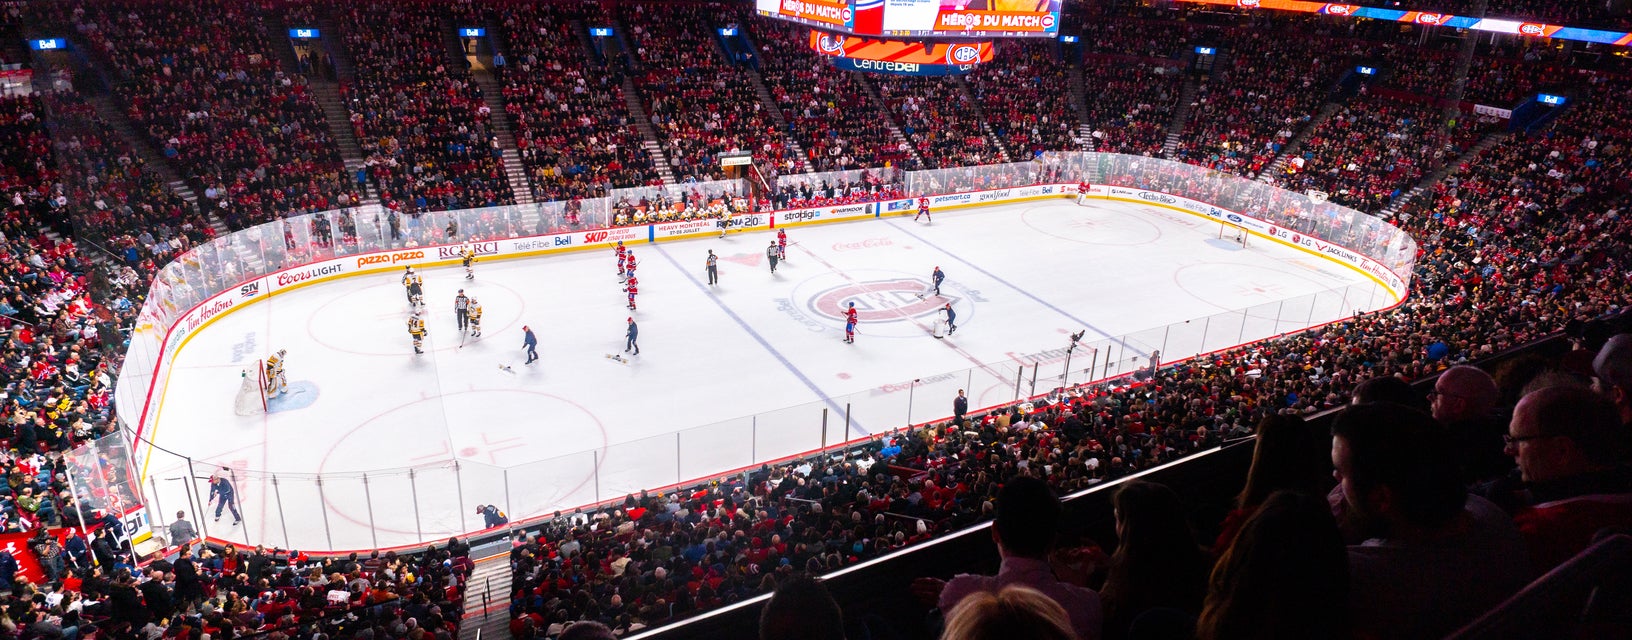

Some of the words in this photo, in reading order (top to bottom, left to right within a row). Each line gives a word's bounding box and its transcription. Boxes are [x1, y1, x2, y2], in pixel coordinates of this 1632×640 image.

[805, 3, 815, 14] DU
[816, 5, 840, 19] MATCH
[942, 13, 981, 26] HÉROS
[983, 15, 1000, 26] DU
[1002, 15, 1040, 27] MATCH
[296, 29, 312, 37] Bell
[466, 28, 479, 37] Bell
[39, 39, 56, 49] Bell
[1544, 95, 1558, 104] Bell
[1042, 186, 1053, 194] Bell
[934, 194, 970, 204] petsmart.ca
[1210, 207, 1222, 217] Bell
[679, 221, 710, 229] MONTRÉAL
[716, 218, 743, 228] RNA
[584, 231, 608, 243] SKIP
[1277, 229, 1287, 238] LG
[513, 240, 531, 251] Télé
[532, 240, 549, 250] Fibe
[554, 236, 572, 246] Bell
[1301, 236, 1312, 247] LG
[474, 242, 498, 253] RCI
[357, 254, 389, 268] pizza
[392, 251, 424, 264] pizza
[277, 270, 311, 286] Coors
[312, 263, 343, 277] LIGHT
[241, 281, 259, 296] SN
[186, 314, 200, 332] Tim
[201, 298, 233, 322] Hortons
